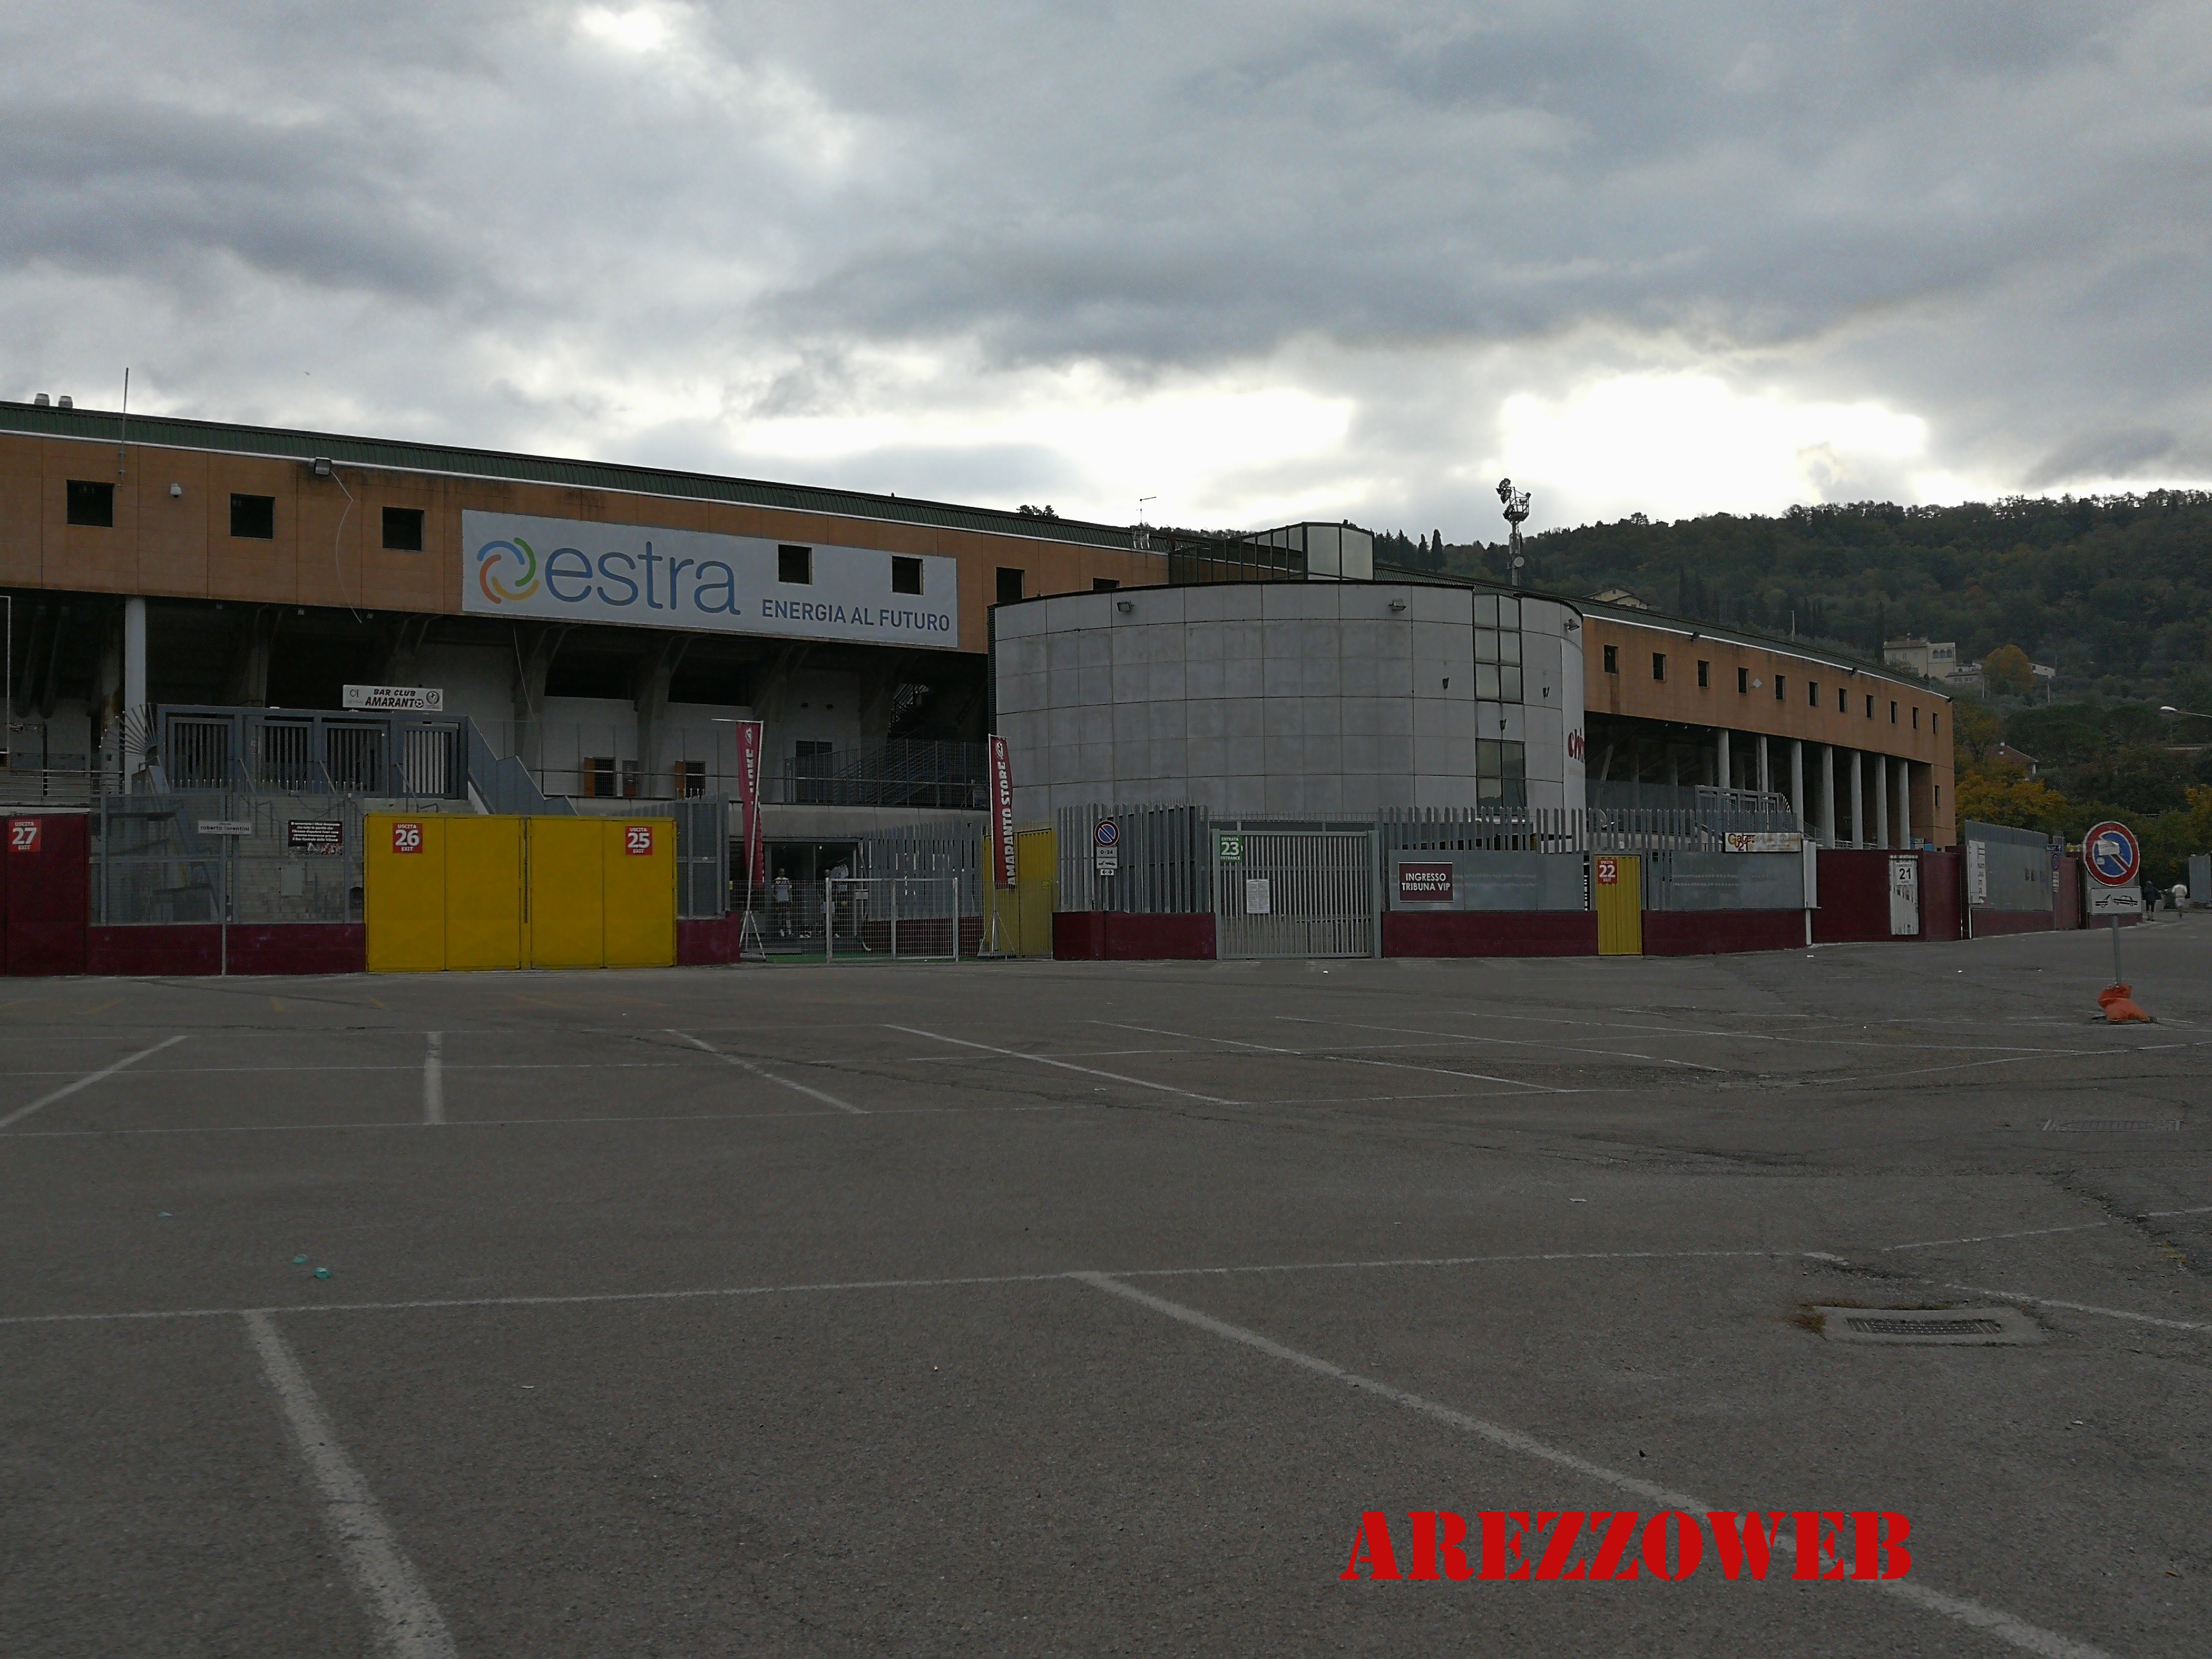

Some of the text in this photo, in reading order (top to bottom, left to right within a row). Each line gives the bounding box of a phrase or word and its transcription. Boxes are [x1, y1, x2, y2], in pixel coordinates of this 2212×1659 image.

[545, 541, 743, 615] estra
[761, 599, 950, 632] ENERGIA AL FUTURO
[997, 761, 1016, 886] AMARANTO STORE
[12, 827, 37, 845] 27
[395, 829, 419, 846] 26
[627, 832, 650, 848] 25
[1221, 841, 1240, 856] 23
[1405, 872, 1446, 881] INGRESSO
[1599, 865, 1616, 878] 22
[1899, 868, 1911, 880] 21
[1401, 882, 1451, 891] TRIBUNA VIP
